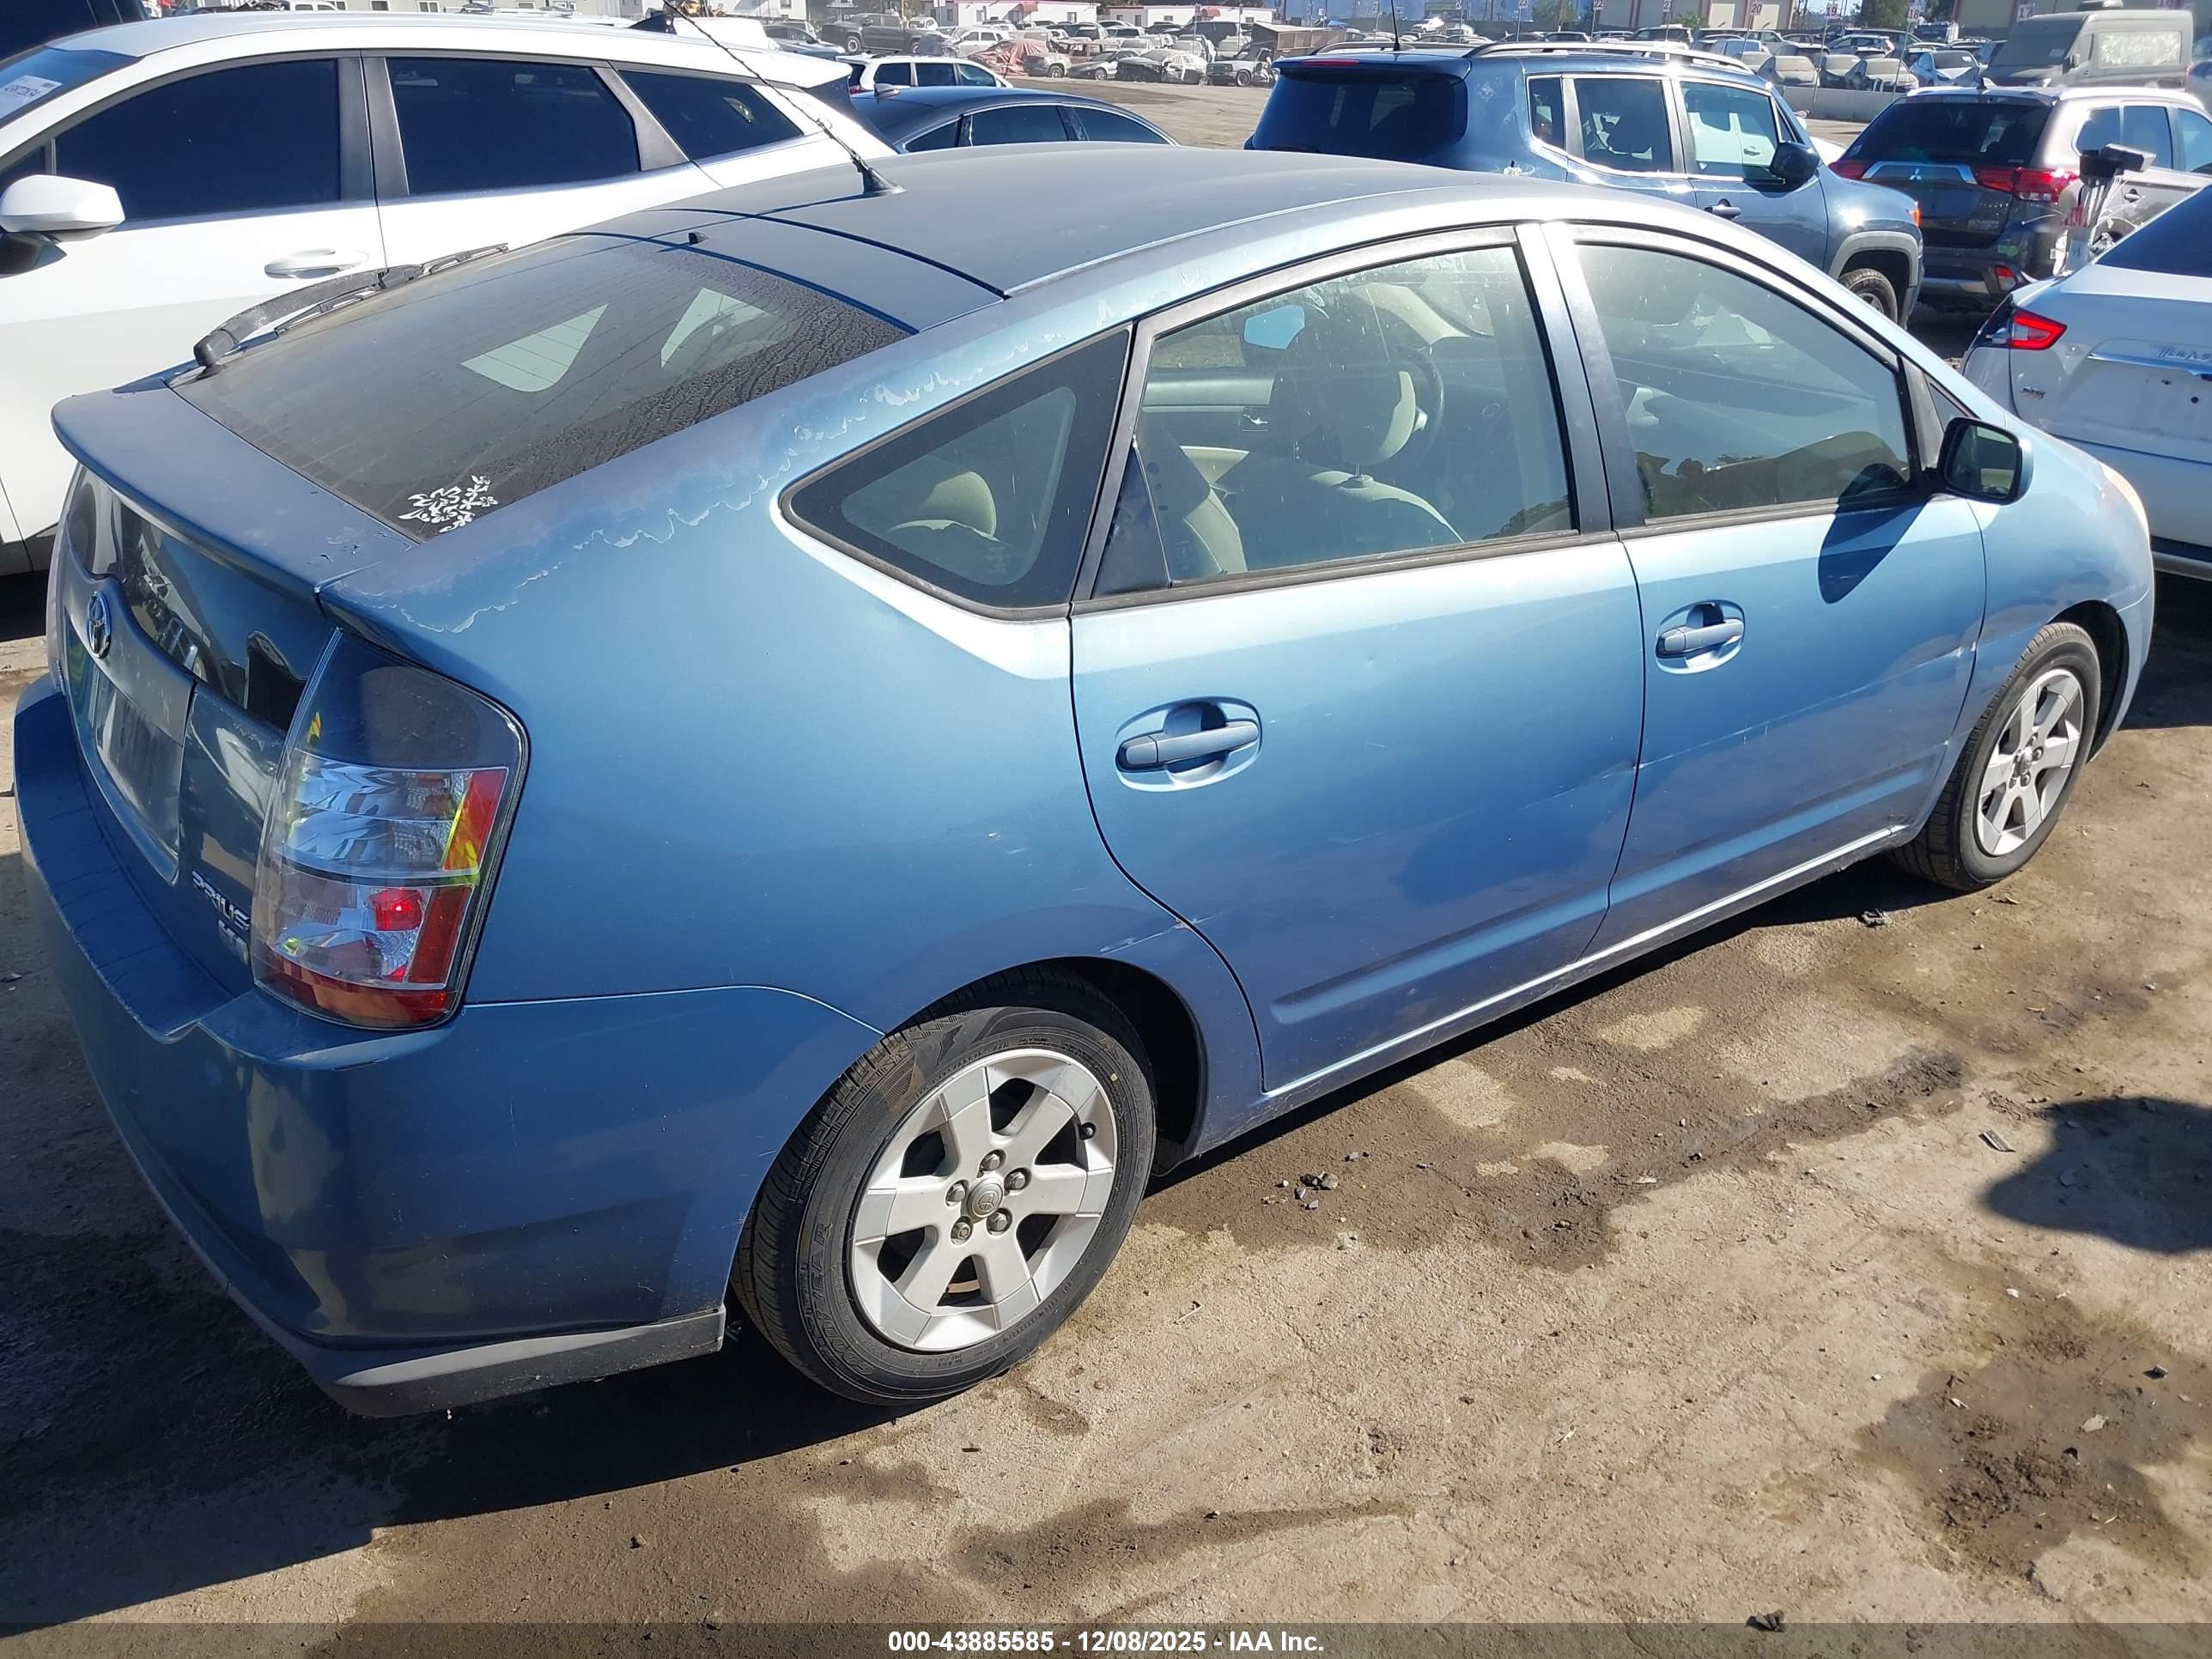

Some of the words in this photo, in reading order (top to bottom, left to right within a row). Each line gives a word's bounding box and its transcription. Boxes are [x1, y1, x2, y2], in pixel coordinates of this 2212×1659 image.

[1752, 4, 1762, 14] 20
[1826, 7, 1838, 16] 19
[1910, 9, 1920, 19] 18
[2019, 7, 2033, 18] 17
[192, 870, 251, 931] PRIUS
[812, 1223, 875, 1377] GOODYEAR
